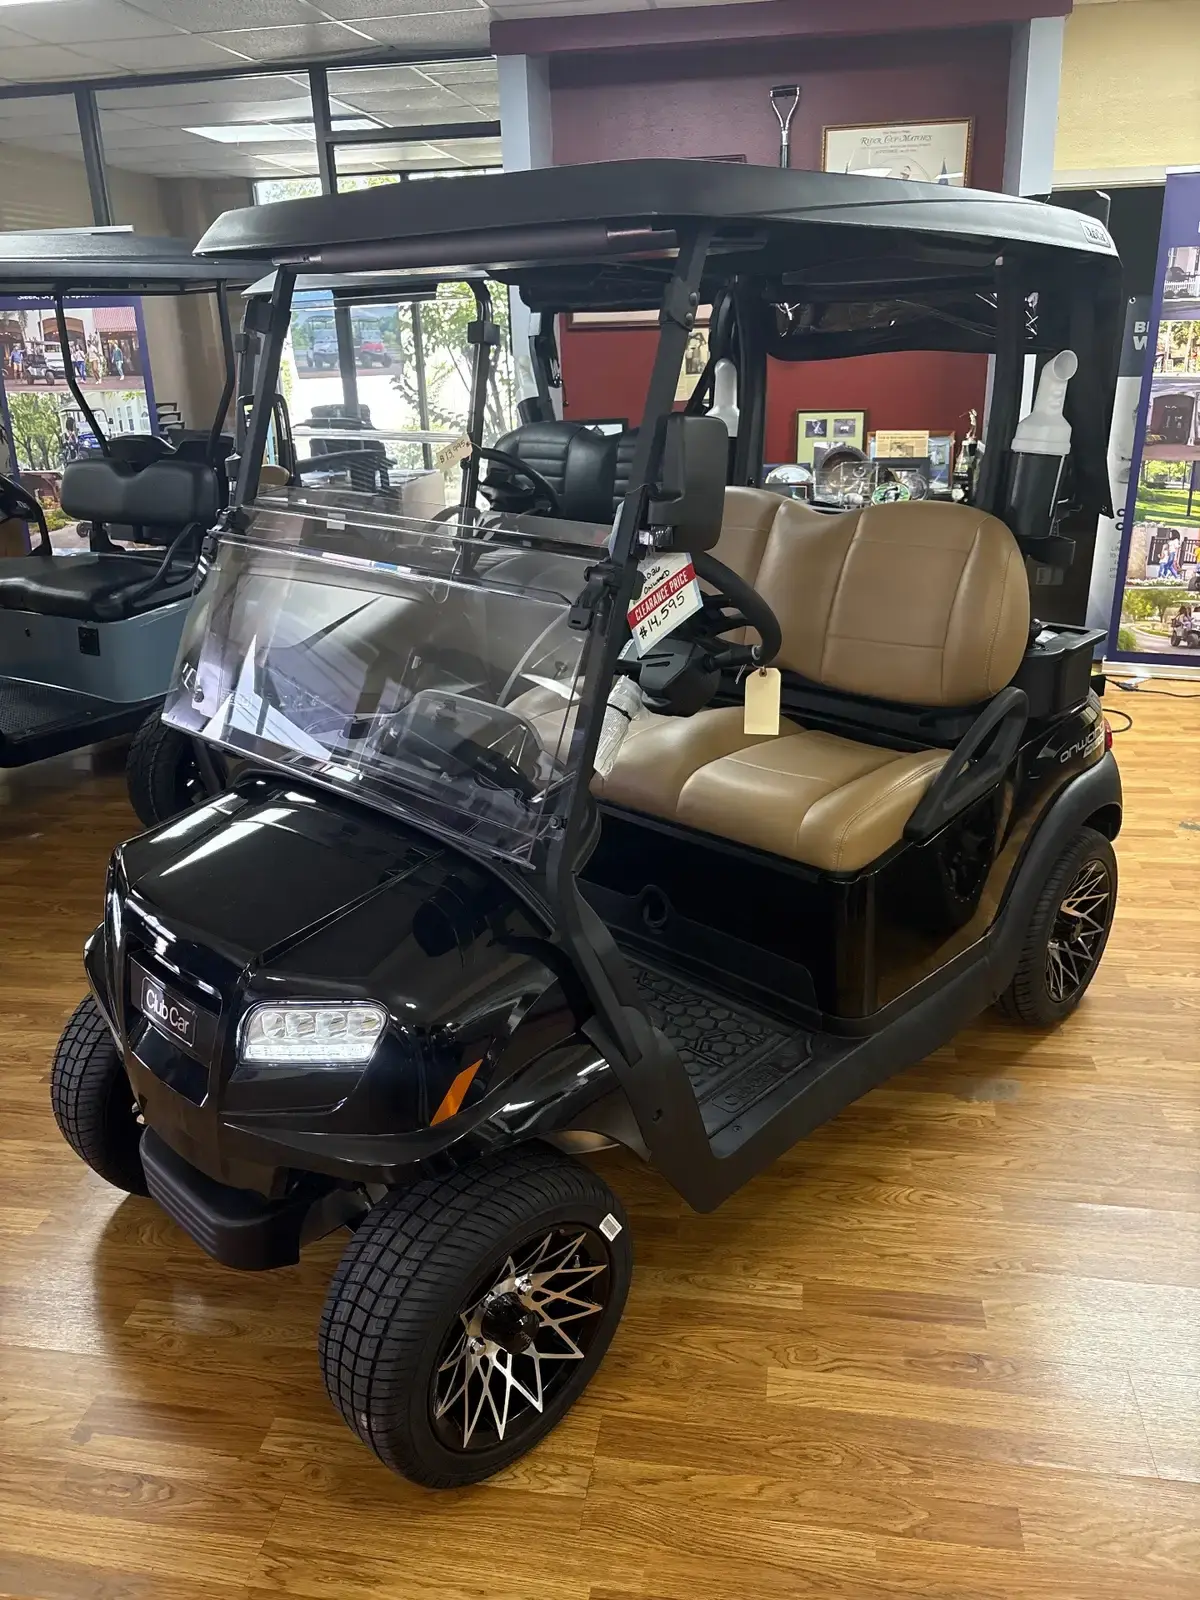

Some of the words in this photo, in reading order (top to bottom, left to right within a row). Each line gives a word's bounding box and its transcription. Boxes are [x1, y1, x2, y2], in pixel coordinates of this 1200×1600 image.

[634, 585, 670, 622] CLEARANCE
[668, 570, 689, 593] PRICE
[146, 988, 169, 1020] Club
[169, 1006, 190, 1034] Car
